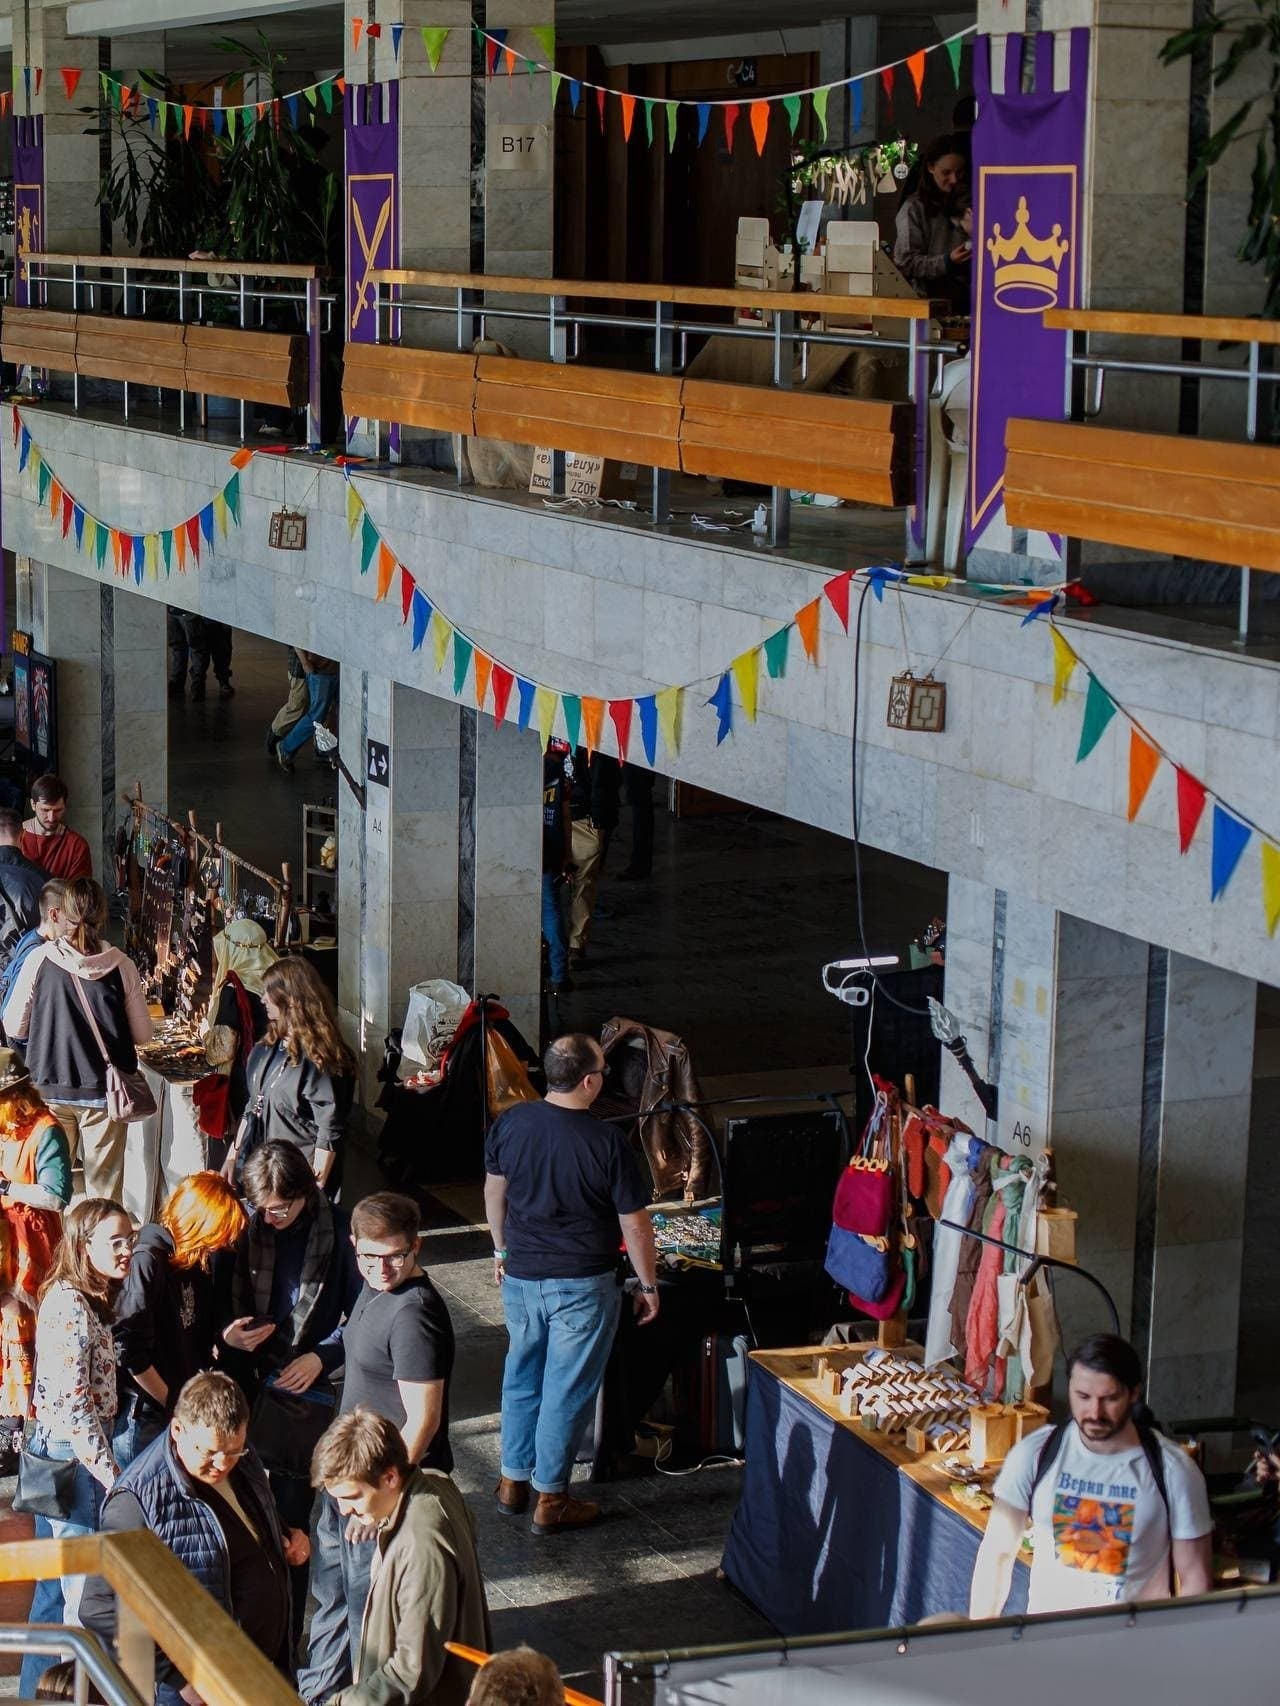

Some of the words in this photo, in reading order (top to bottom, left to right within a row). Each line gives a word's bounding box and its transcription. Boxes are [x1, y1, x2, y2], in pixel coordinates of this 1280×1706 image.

[502, 136, 535, 153] B17
[570, 481, 597, 496] 4027
[372, 817, 383, 834] A4
[1012, 1120, 1032, 1147] A6
[1060, 1471, 1105, 1496] Верни
[1108, 1483, 1138, 1499] мне
